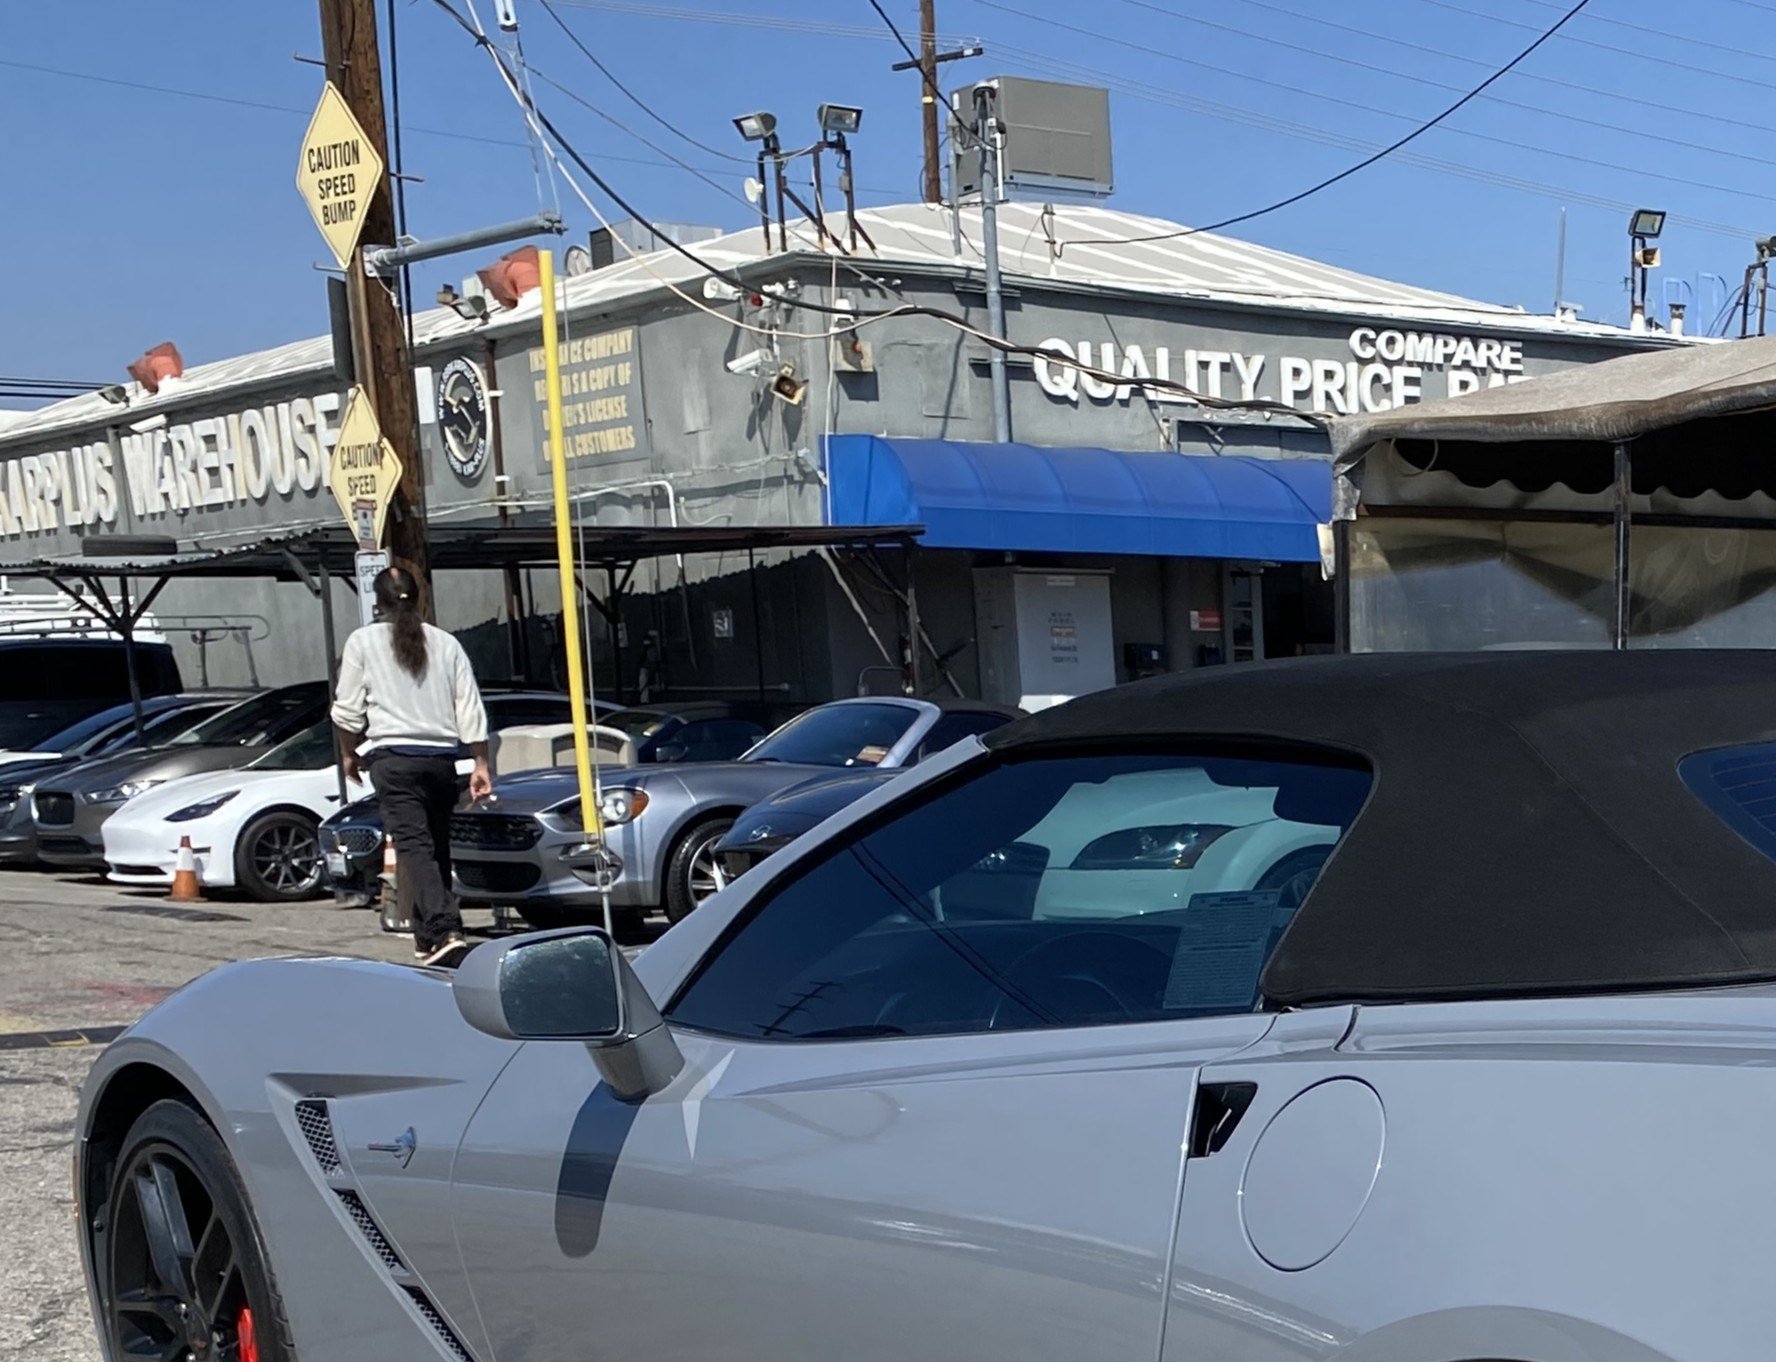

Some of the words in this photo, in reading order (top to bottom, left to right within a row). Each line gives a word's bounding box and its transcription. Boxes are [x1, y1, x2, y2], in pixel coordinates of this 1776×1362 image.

[308, 140, 360, 173] CAUTION
[318, 173, 355, 199] SPEED
[322, 200, 356, 225] BUMP
[583, 329, 633, 361] COMPANY
[1350, 328, 1524, 371] COMPARE
[589, 364, 617, 391] COPY
[617, 362, 632, 386] OF
[1280, 355, 1422, 415] PRICE
[585, 395, 628, 423] LICENSE
[575, 425, 636, 456] CUSTOMERS
[0, 441, 119, 536] ARPLUS
[120, 392, 340, 516] WAREHOUSE
[341, 443, 381, 470] CAUTION
[347, 474, 376, 497] SPEED
